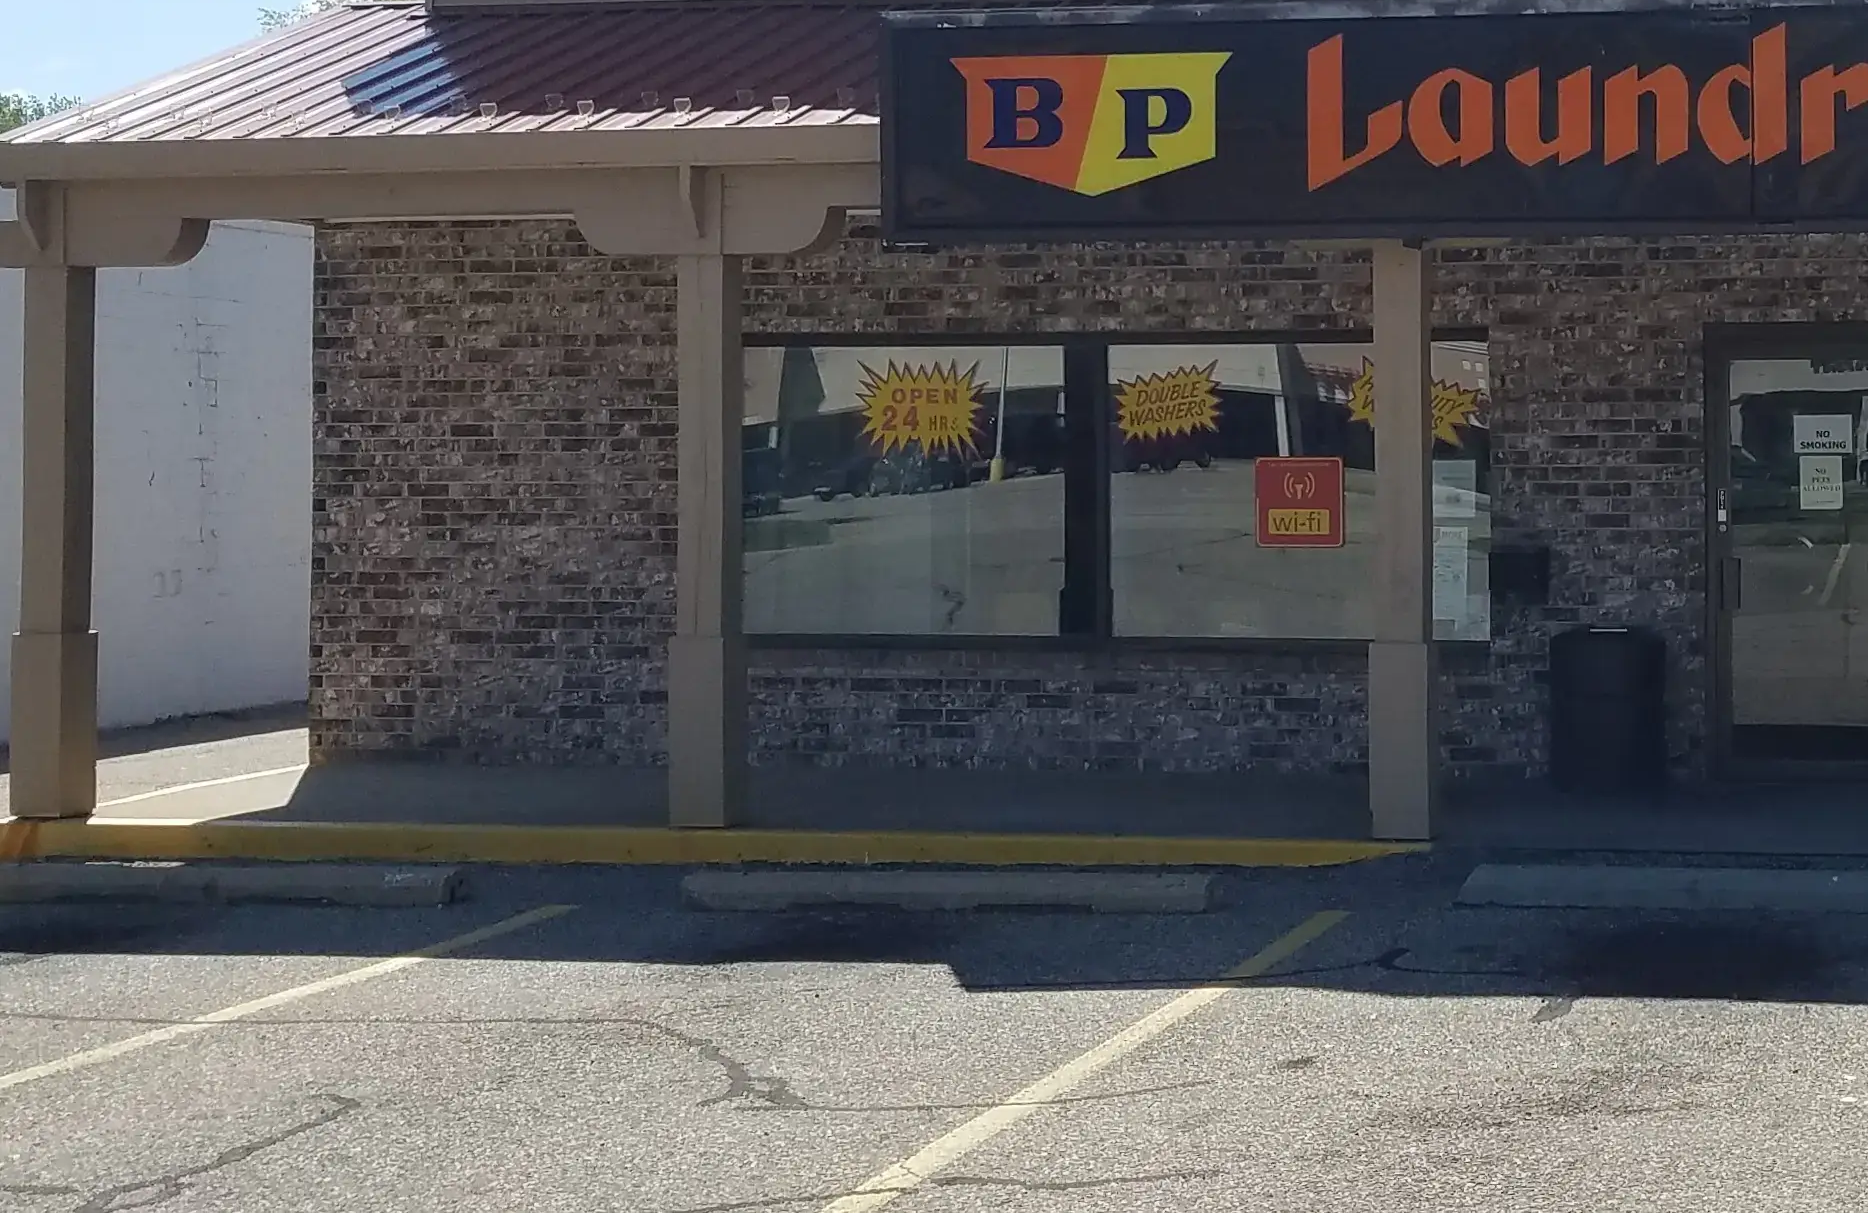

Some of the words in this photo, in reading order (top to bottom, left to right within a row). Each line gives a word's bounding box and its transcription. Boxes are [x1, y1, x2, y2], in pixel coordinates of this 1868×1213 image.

[891, 388, 958, 405] OPEN
[1135, 381, 1202, 407] DOUBLE
[881, 404, 919, 431] 24
[1129, 399, 1206, 426] WASHERS
[1816, 430, 1830, 438] NO
[1800, 441, 1847, 449] SMOKING
[1273, 511, 1321, 532] wi-fi
